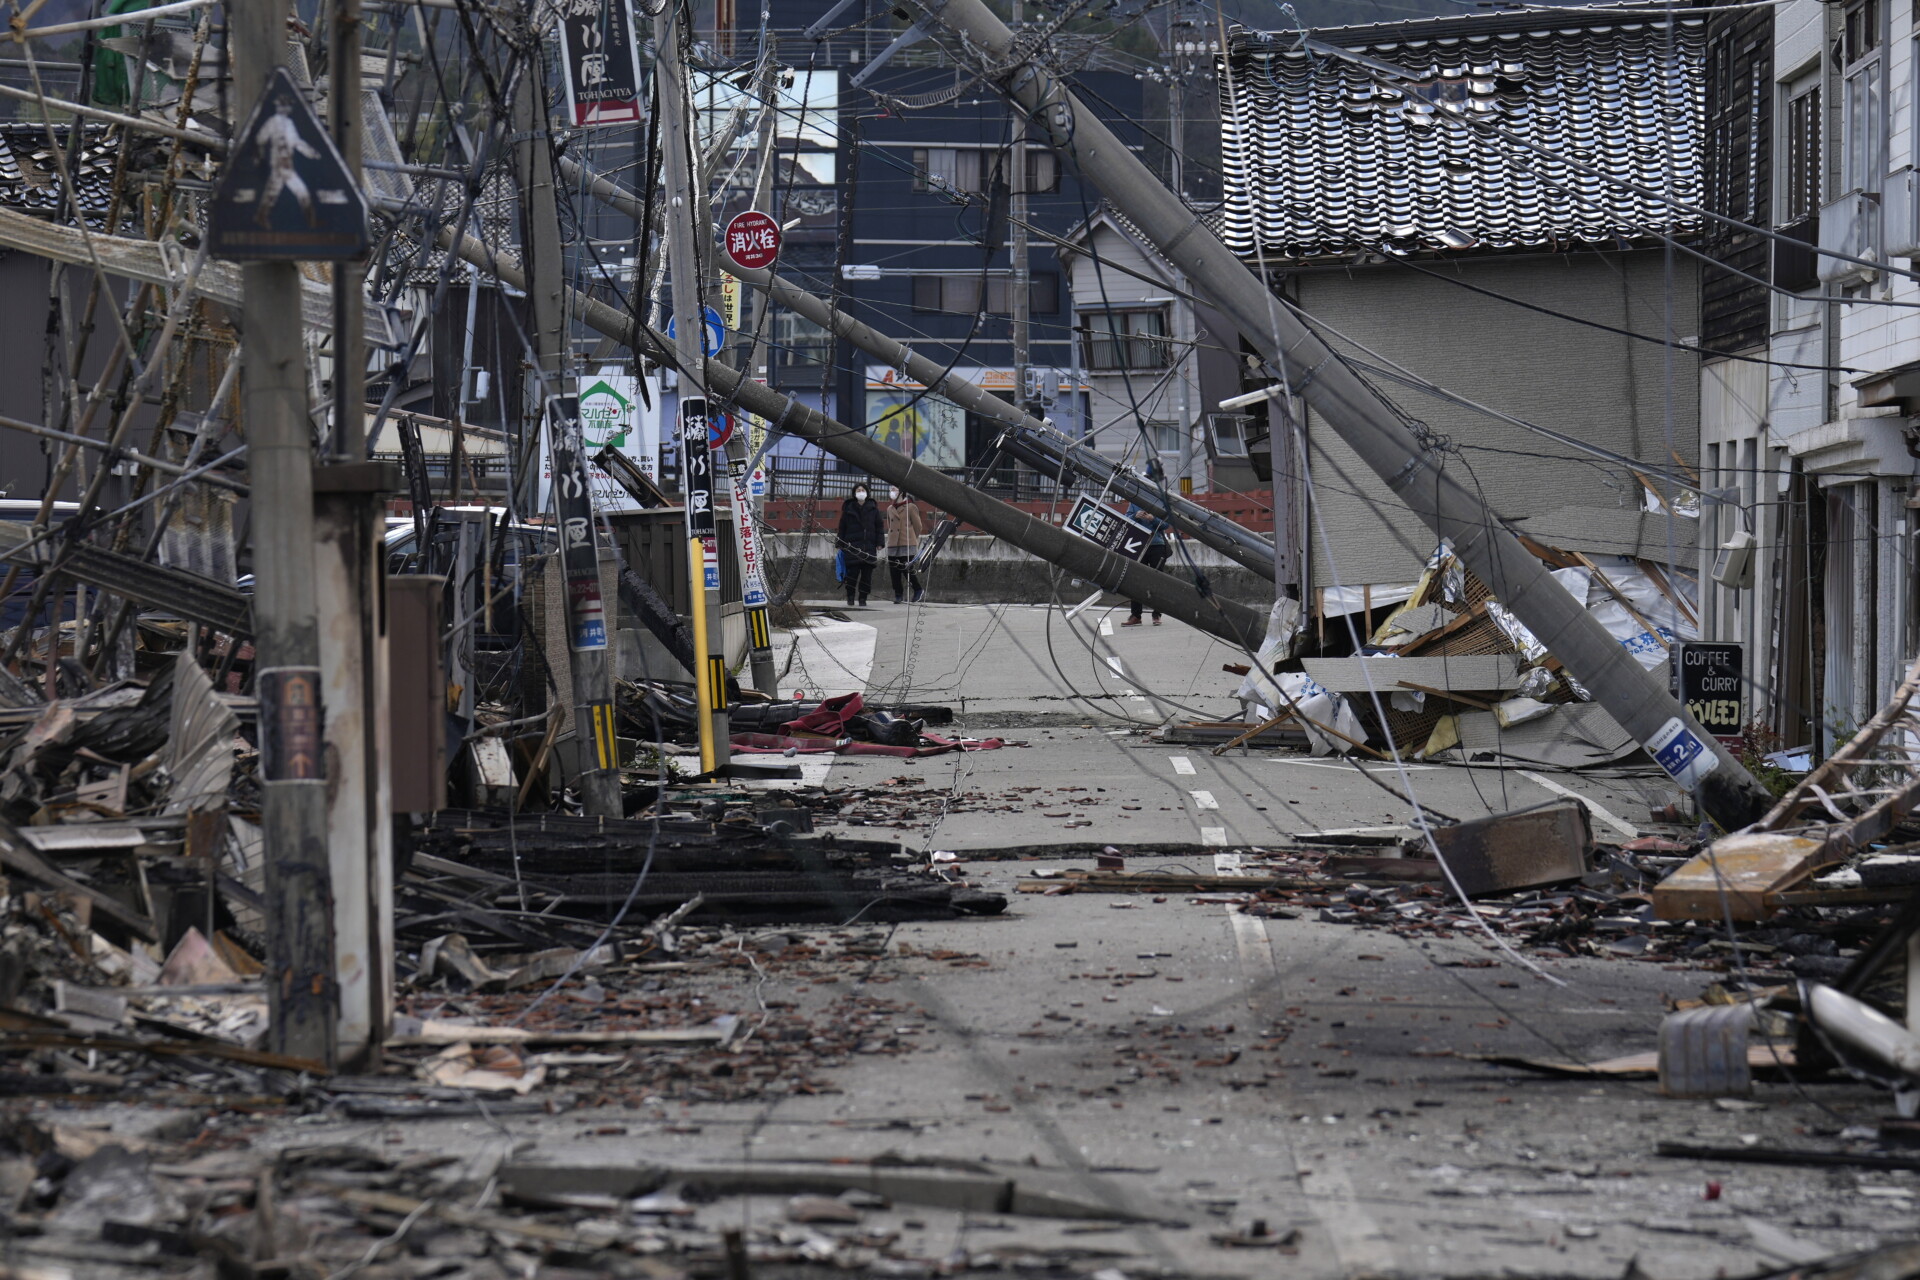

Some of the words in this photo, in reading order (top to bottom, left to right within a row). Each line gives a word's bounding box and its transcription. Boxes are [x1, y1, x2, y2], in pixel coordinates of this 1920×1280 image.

[578, 87, 632, 100] TOHACHIYA
[746, 218, 768, 227] HYDRANT
[730, 227, 776, 254] 消火栓
[581, 406, 622, 419] マルゼン
[588, 420, 613, 429] 不動産
[728, 462, 747, 476] 注意
[1685, 651, 1730, 666] COFFEE
[1707, 666, 1716, 676] &
[1701, 677, 1739, 692] CURRY
